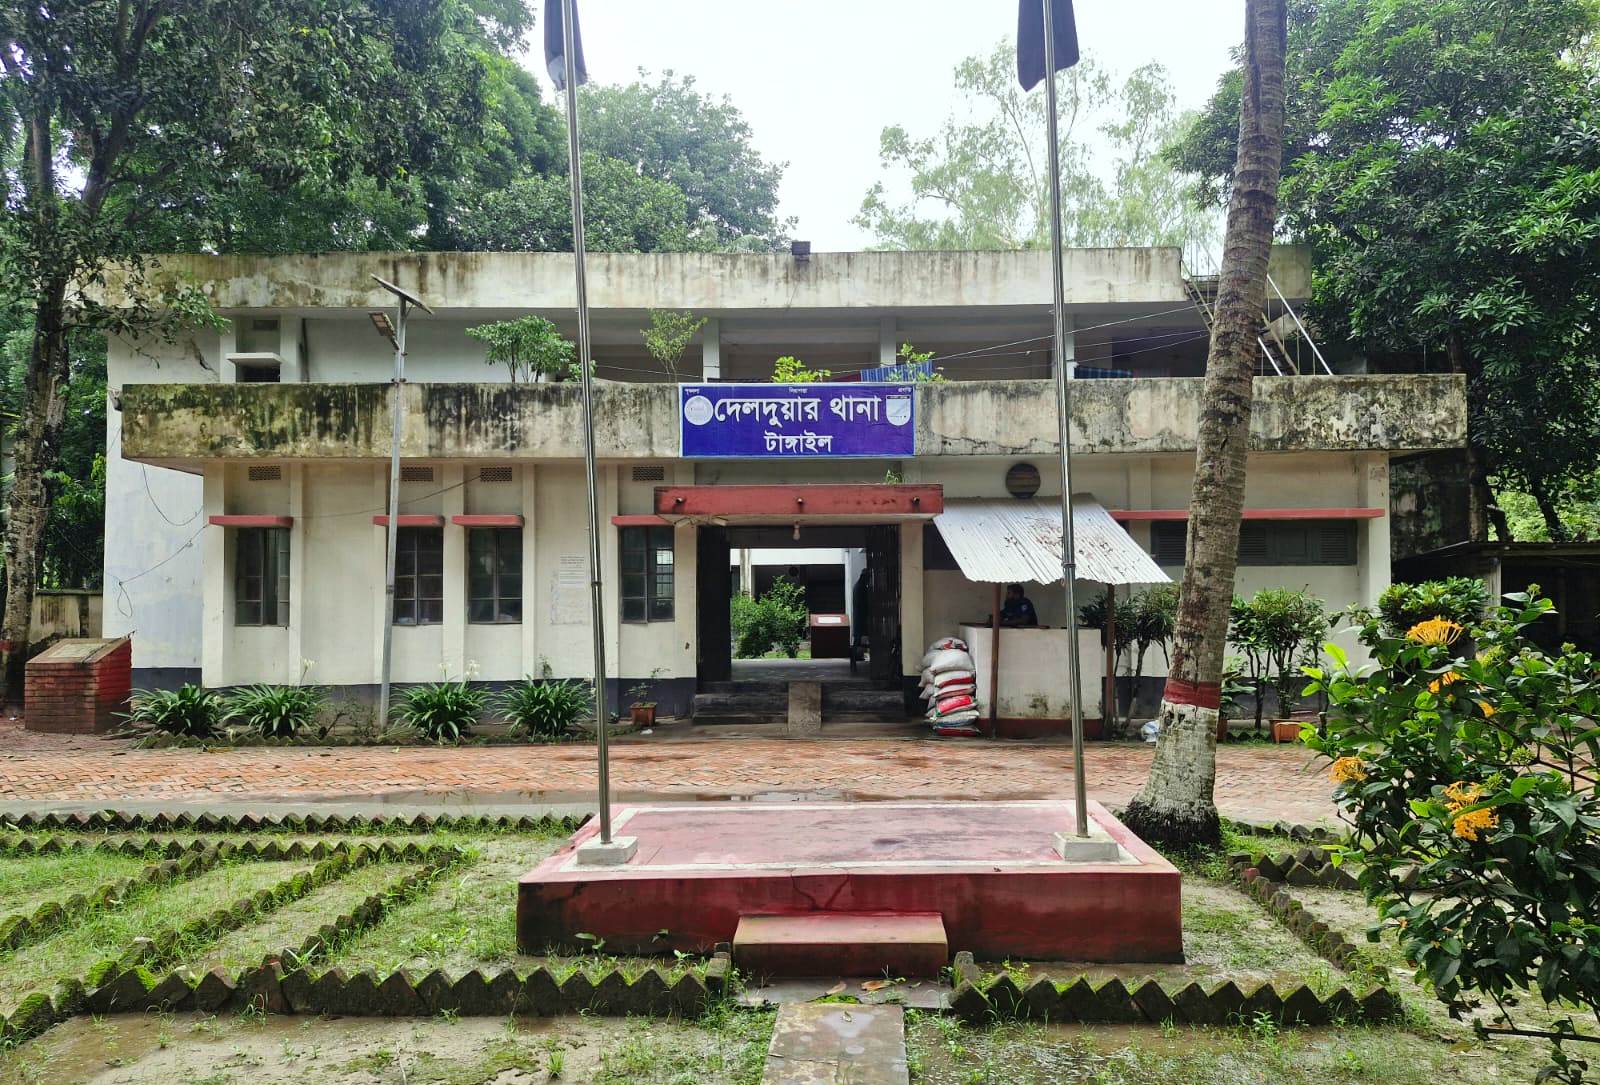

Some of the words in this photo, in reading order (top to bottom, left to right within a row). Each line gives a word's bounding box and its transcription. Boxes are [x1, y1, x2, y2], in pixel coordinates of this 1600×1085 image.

[714, 395, 822, 428] দেলদুয়ার
[830, 394, 882, 422] থানা
[763, 429, 834, 454] টাঙ্গাইল
